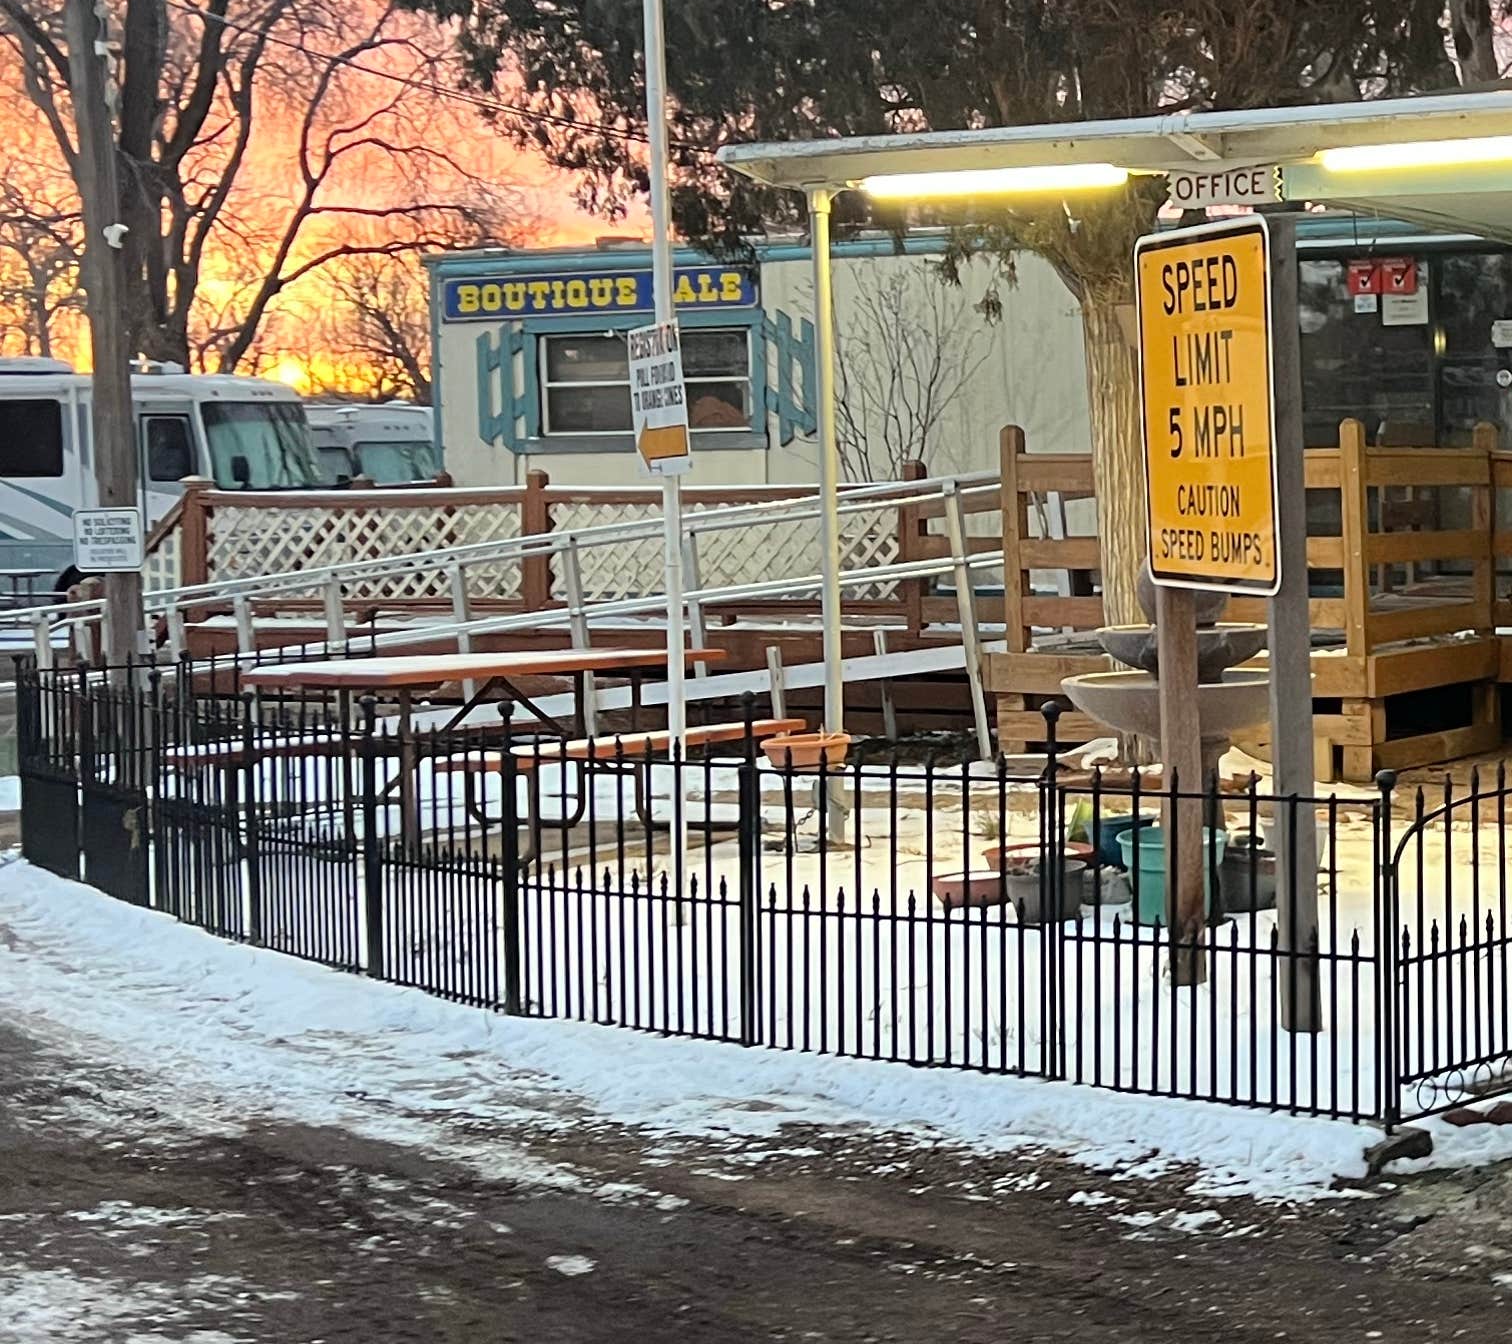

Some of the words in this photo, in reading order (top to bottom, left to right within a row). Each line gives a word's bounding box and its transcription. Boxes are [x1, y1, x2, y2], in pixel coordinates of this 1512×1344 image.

[1176, 171, 1265, 201] OFFICE
[457, 277, 637, 313] BOUTIQUE
[673, 272, 742, 303] ALE
[1162, 254, 1238, 316] SPEED
[1173, 329, 1233, 386] LIMIT
[1169, 407, 1183, 458] 5
[1194, 404, 1245, 458] MPH
[1178, 484, 1240, 517] CAUTION
[1161, 528, 1205, 561] SPEED
[1211, 531, 1263, 566] BUMPS
